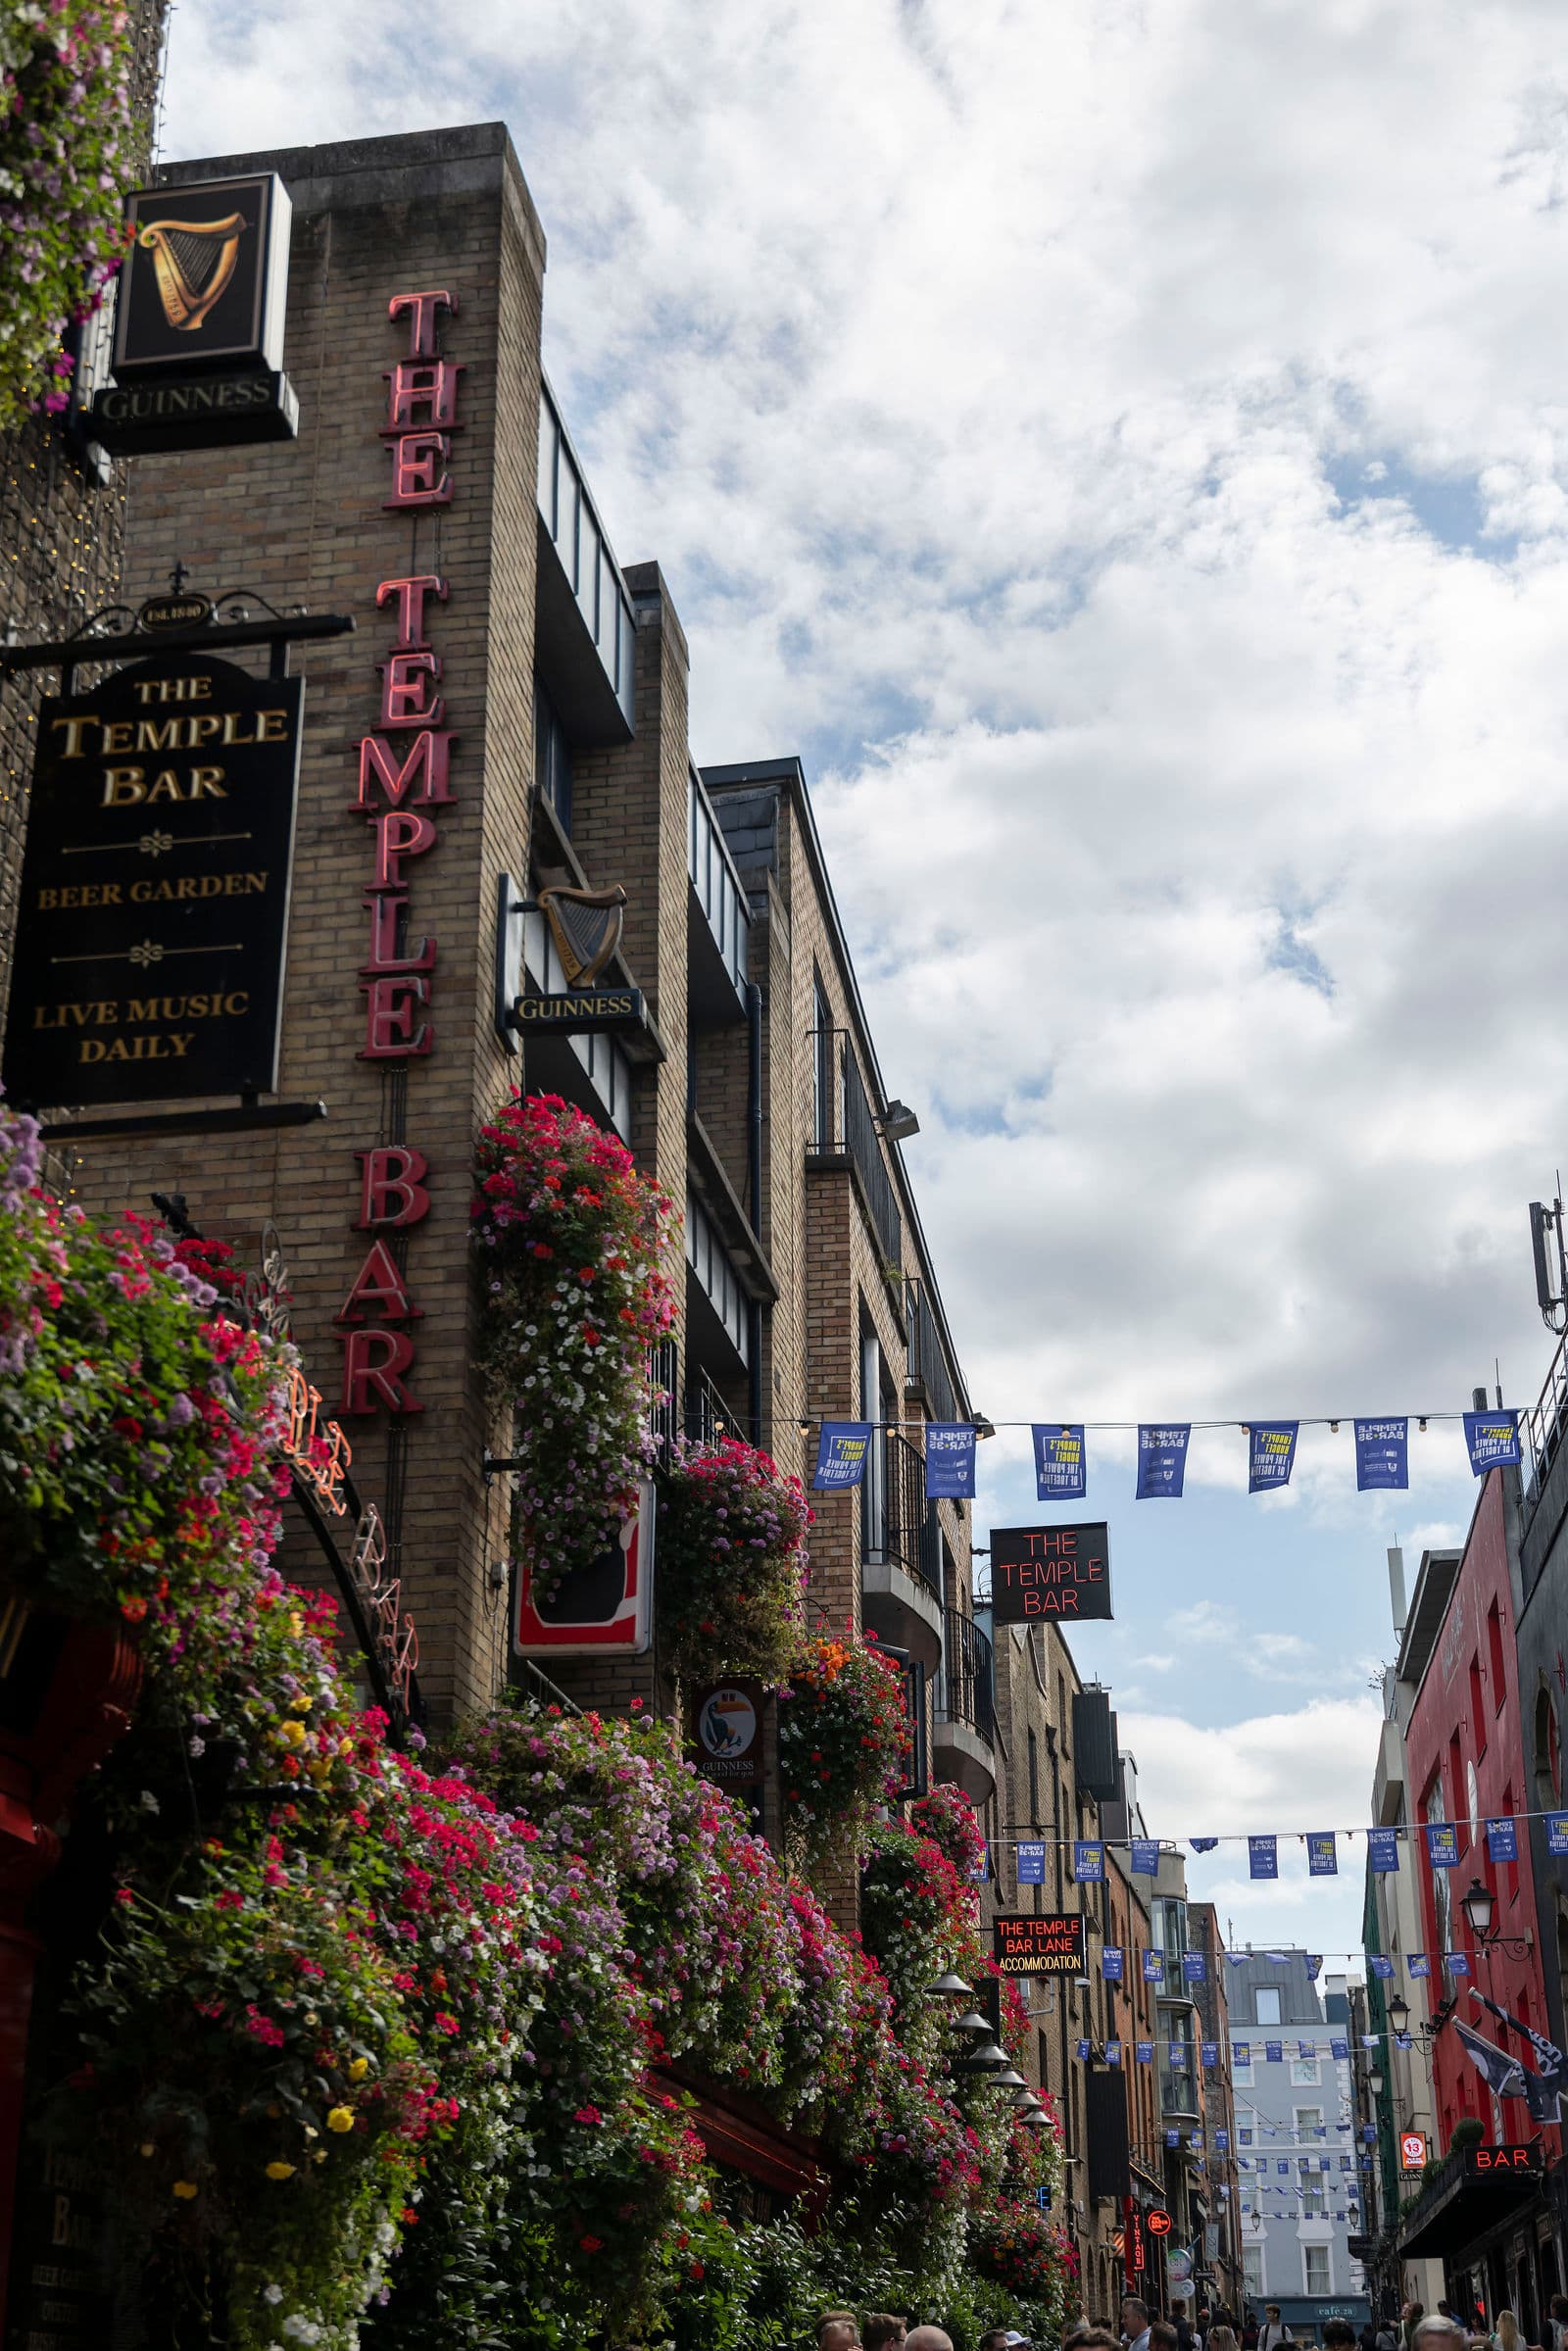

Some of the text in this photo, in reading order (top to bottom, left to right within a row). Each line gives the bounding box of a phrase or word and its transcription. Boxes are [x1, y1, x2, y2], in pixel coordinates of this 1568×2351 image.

[101, 379, 270, 420] GUINNESS
[378, 289, 467, 513] THE
[134, 676, 212, 704] THE
[52, 709, 289, 759] TEMPLE
[99, 765, 229, 808] BAR
[347, 574, 459, 1059] TEMPLE
[37, 871, 269, 910] BEER GARDEN
[33, 991, 250, 1029] LIVE MUSIC
[518, 996, 632, 1019] GUINNESS
[78, 1034, 196, 1063] DAILY
[328, 1147, 430, 1415] BAR
[1023, 1532, 1078, 1556] THE
[1000, 1559, 1103, 1587] TEMPLE
[1024, 1589, 1079, 1615] BAR
[703, 1760, 754, 1772] GUINNESS
[998, 1920, 1079, 1936] THE TEMPLE
[1005, 1937, 1073, 1953] BAR LANE
[1000, 1955, 1081, 1972] ACCOMMODATION
[1406, 2143, 1420, 2153] 13
[1477, 2149, 1529, 2168] BAR
[1133, 2215, 1142, 2265] VINTAGE
